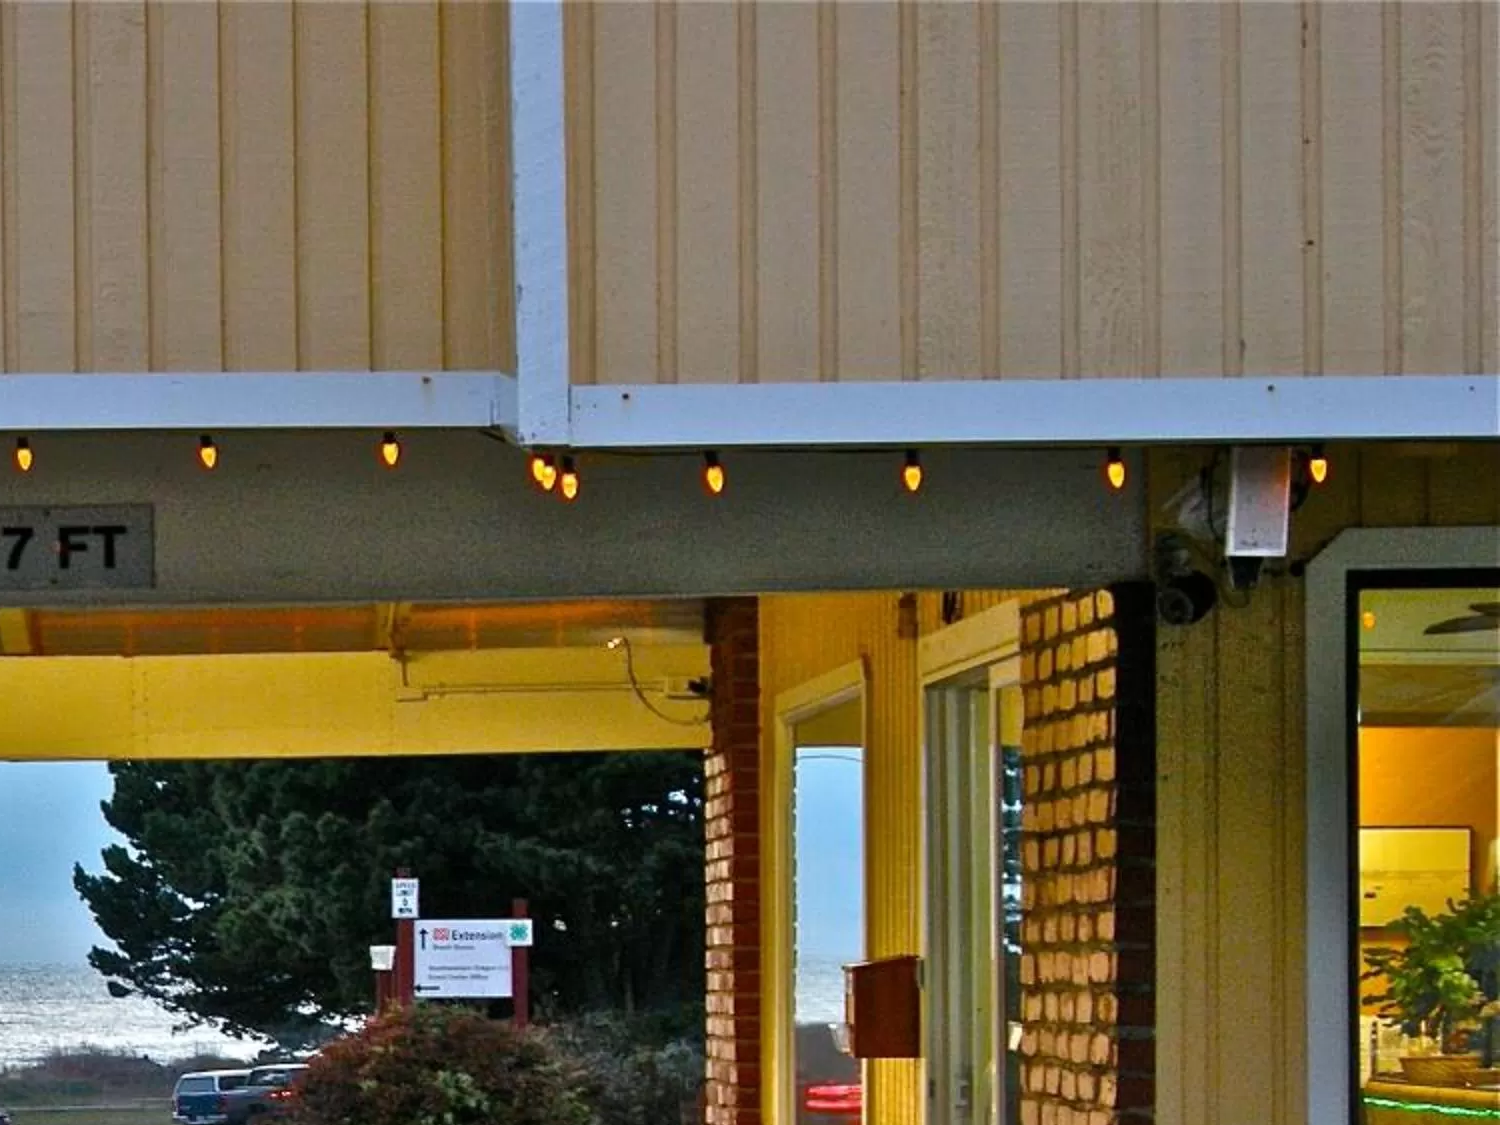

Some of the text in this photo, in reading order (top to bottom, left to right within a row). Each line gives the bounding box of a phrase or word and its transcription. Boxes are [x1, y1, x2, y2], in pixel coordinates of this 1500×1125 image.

[2, 527, 34, 570] 7
[57, 525, 127, 570] FT
[451, 929, 504, 941] Extension
